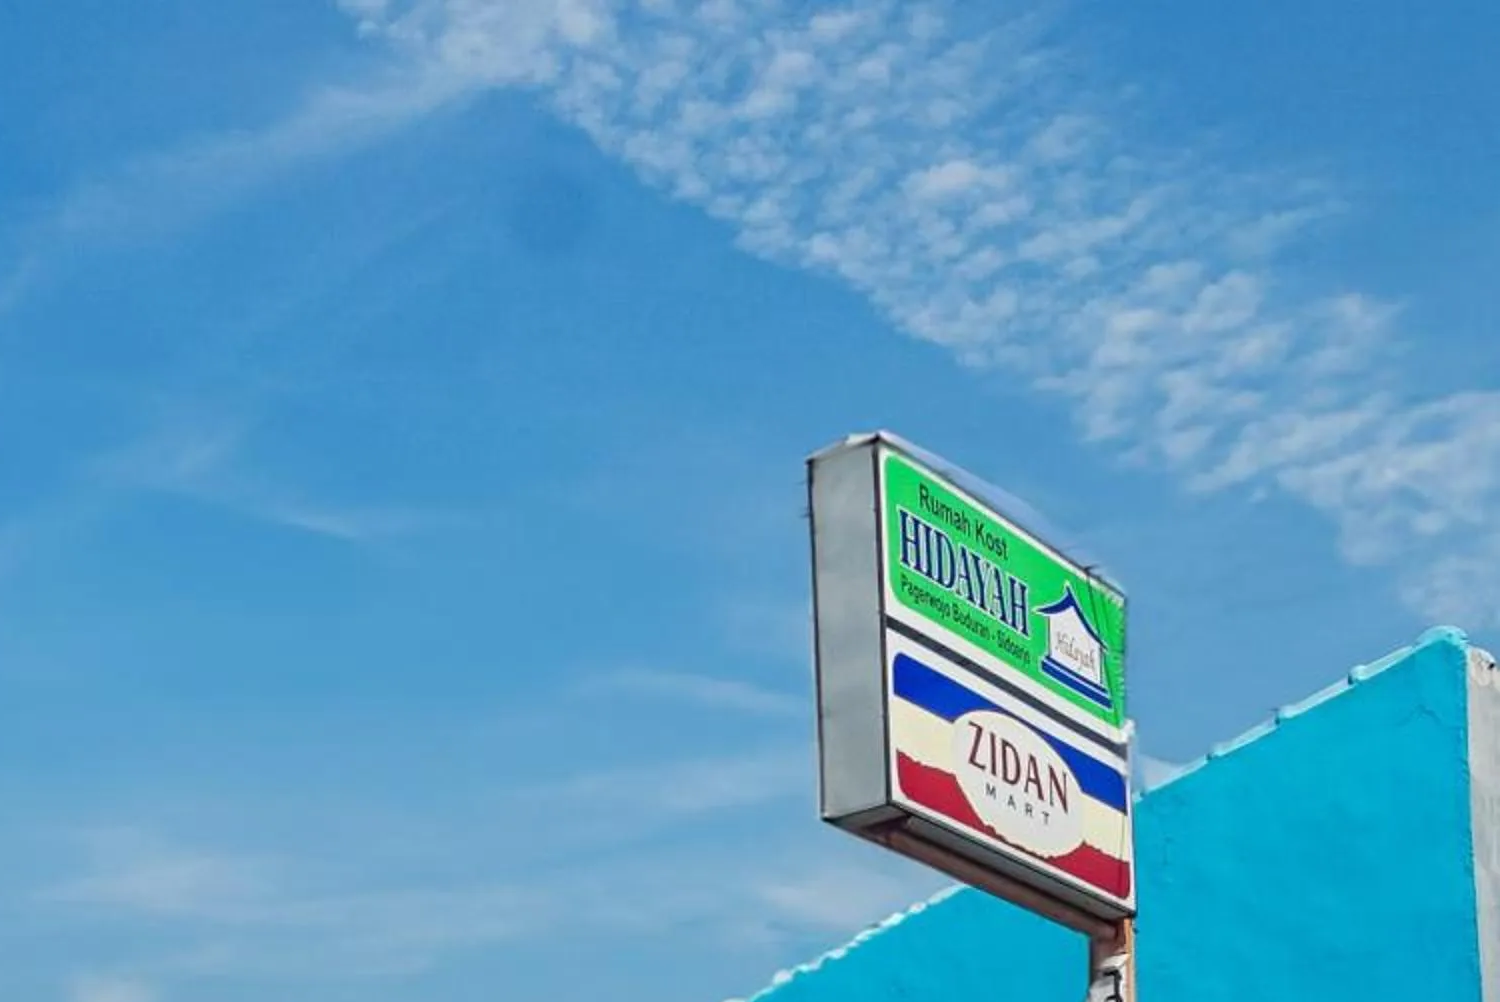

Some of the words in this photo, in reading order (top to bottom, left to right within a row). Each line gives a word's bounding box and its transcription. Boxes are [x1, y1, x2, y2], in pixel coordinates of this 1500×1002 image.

[918, 481, 971, 538] Rumah
[975, 519, 1008, 561] Kost
[898, 506, 1029, 637] HIDAYAH
[968, 720, 1069, 815] ZIDAN
[985, 782, 1050, 825] MART
